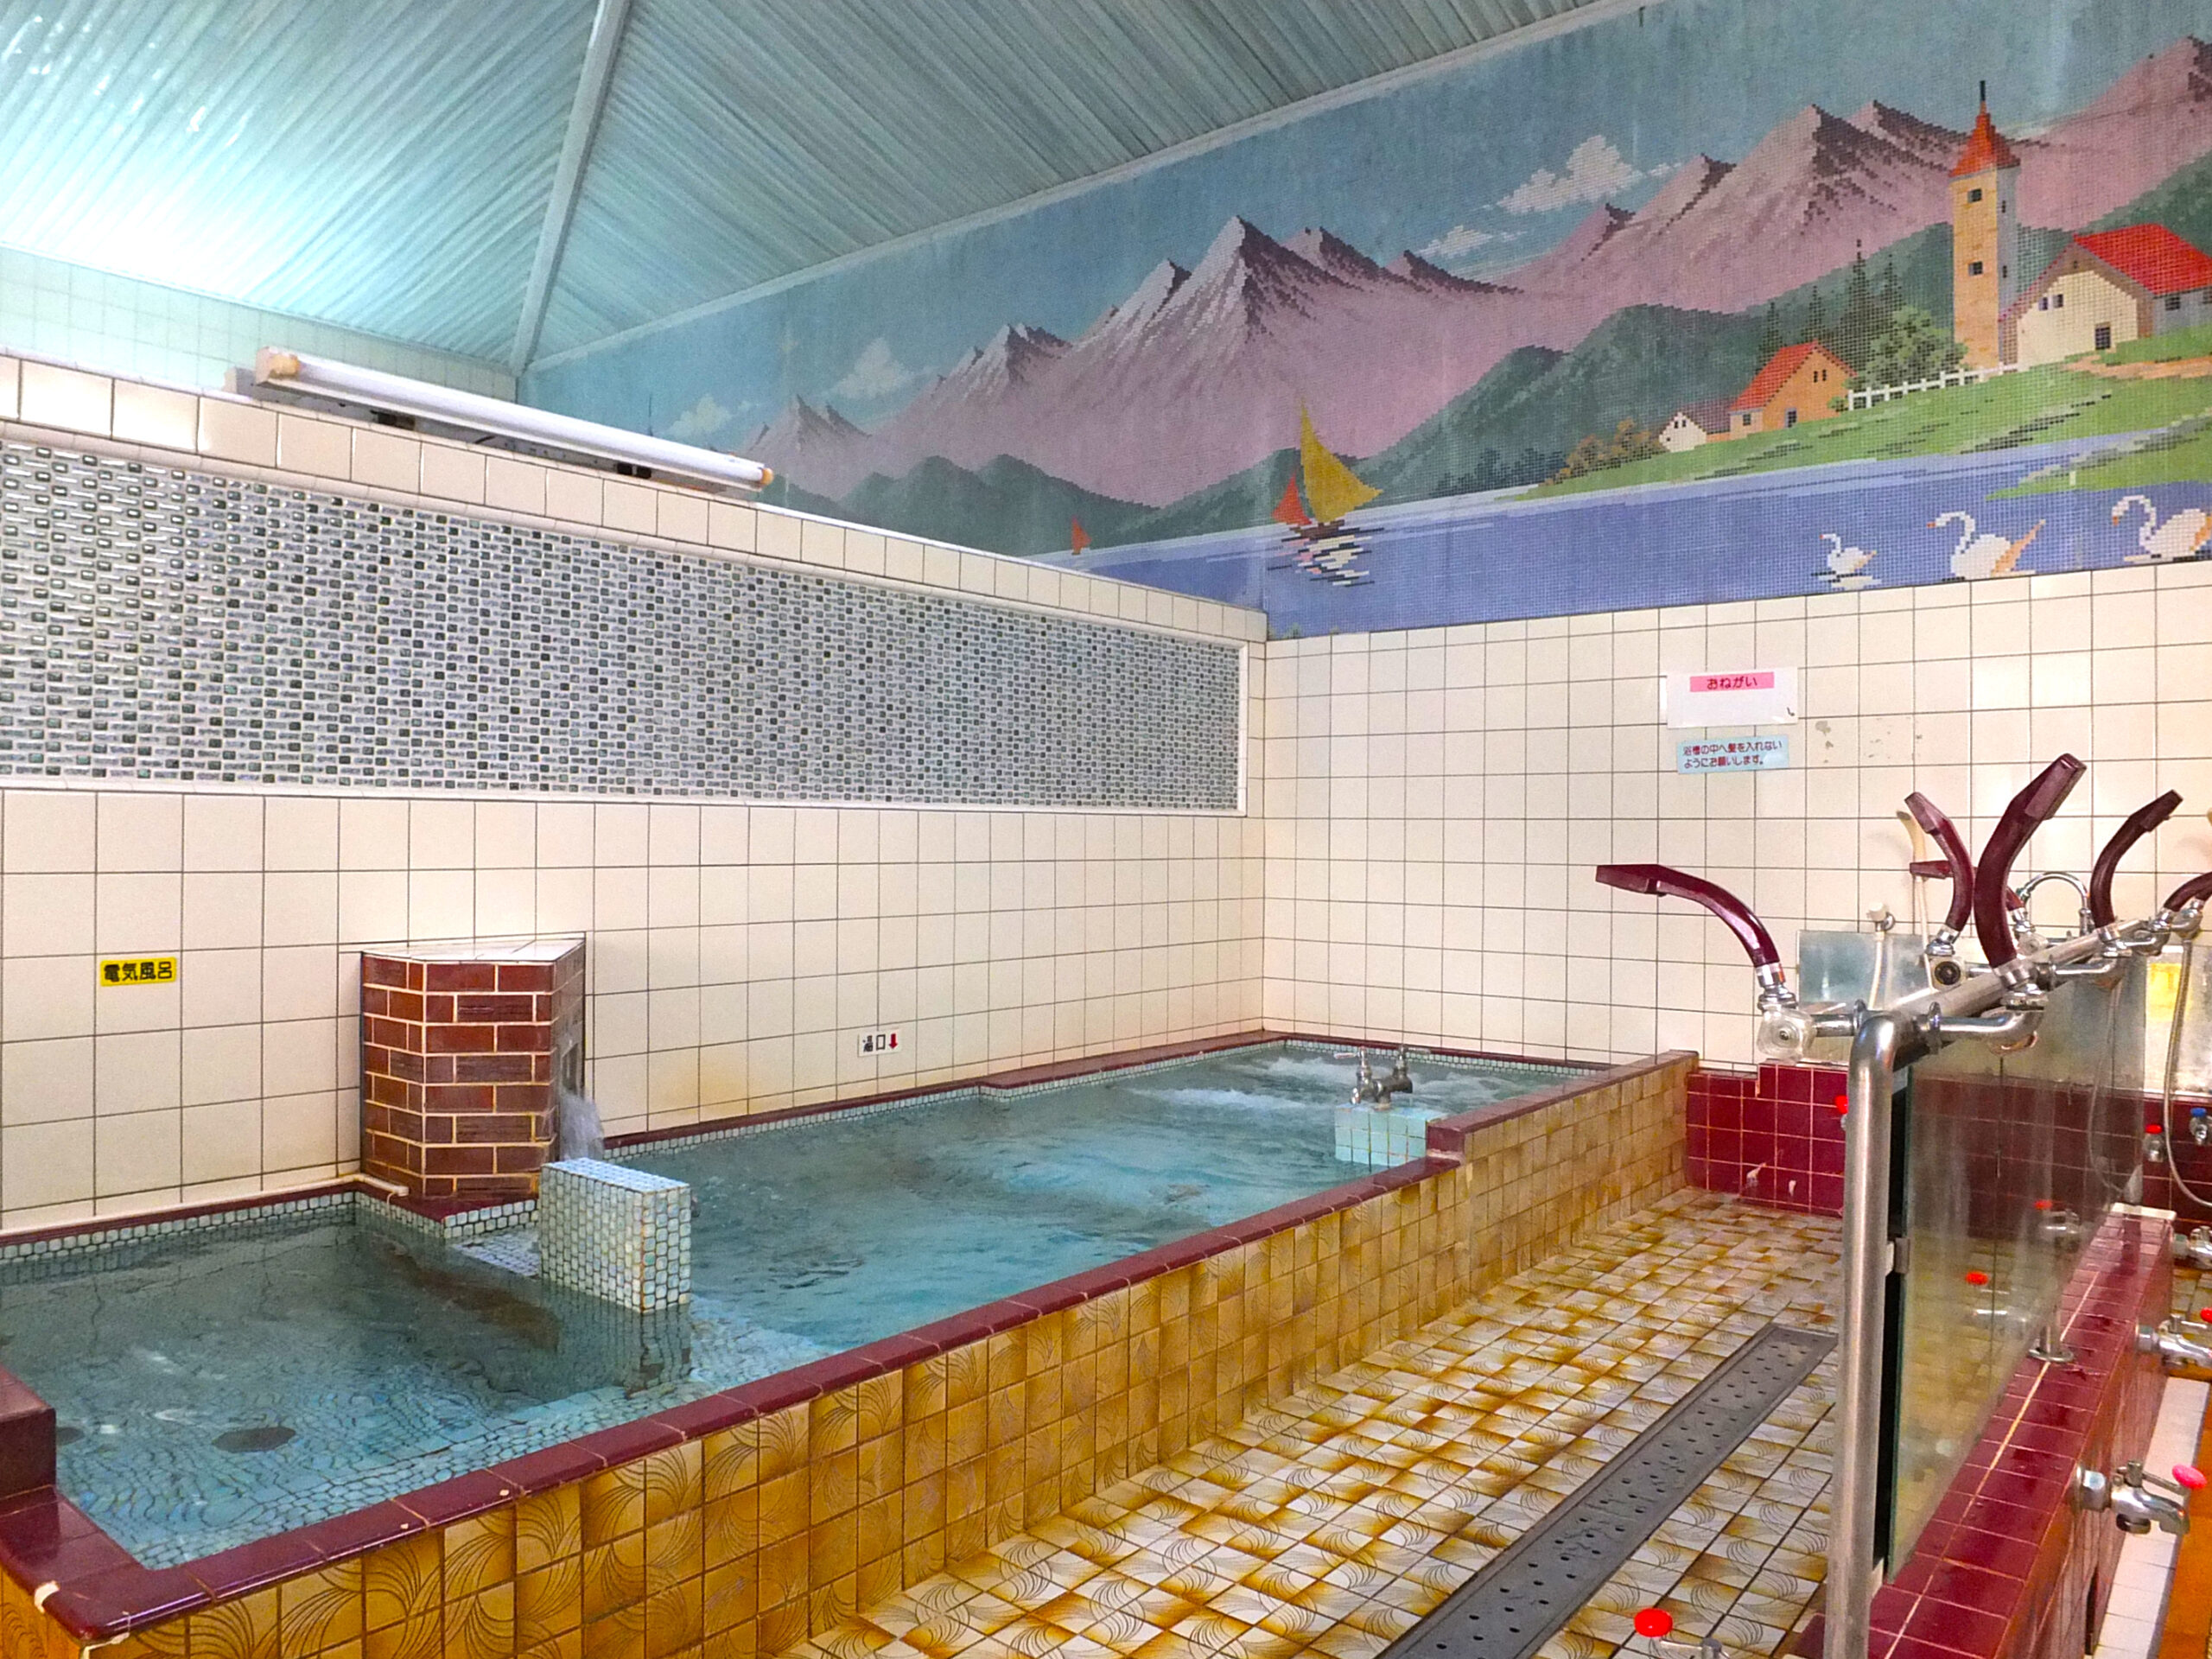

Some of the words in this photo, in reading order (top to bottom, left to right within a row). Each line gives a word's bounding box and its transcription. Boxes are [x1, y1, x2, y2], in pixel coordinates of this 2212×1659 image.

[1707, 676, 1758, 690] おねがい
[104, 961, 173, 982] 電気風呂
